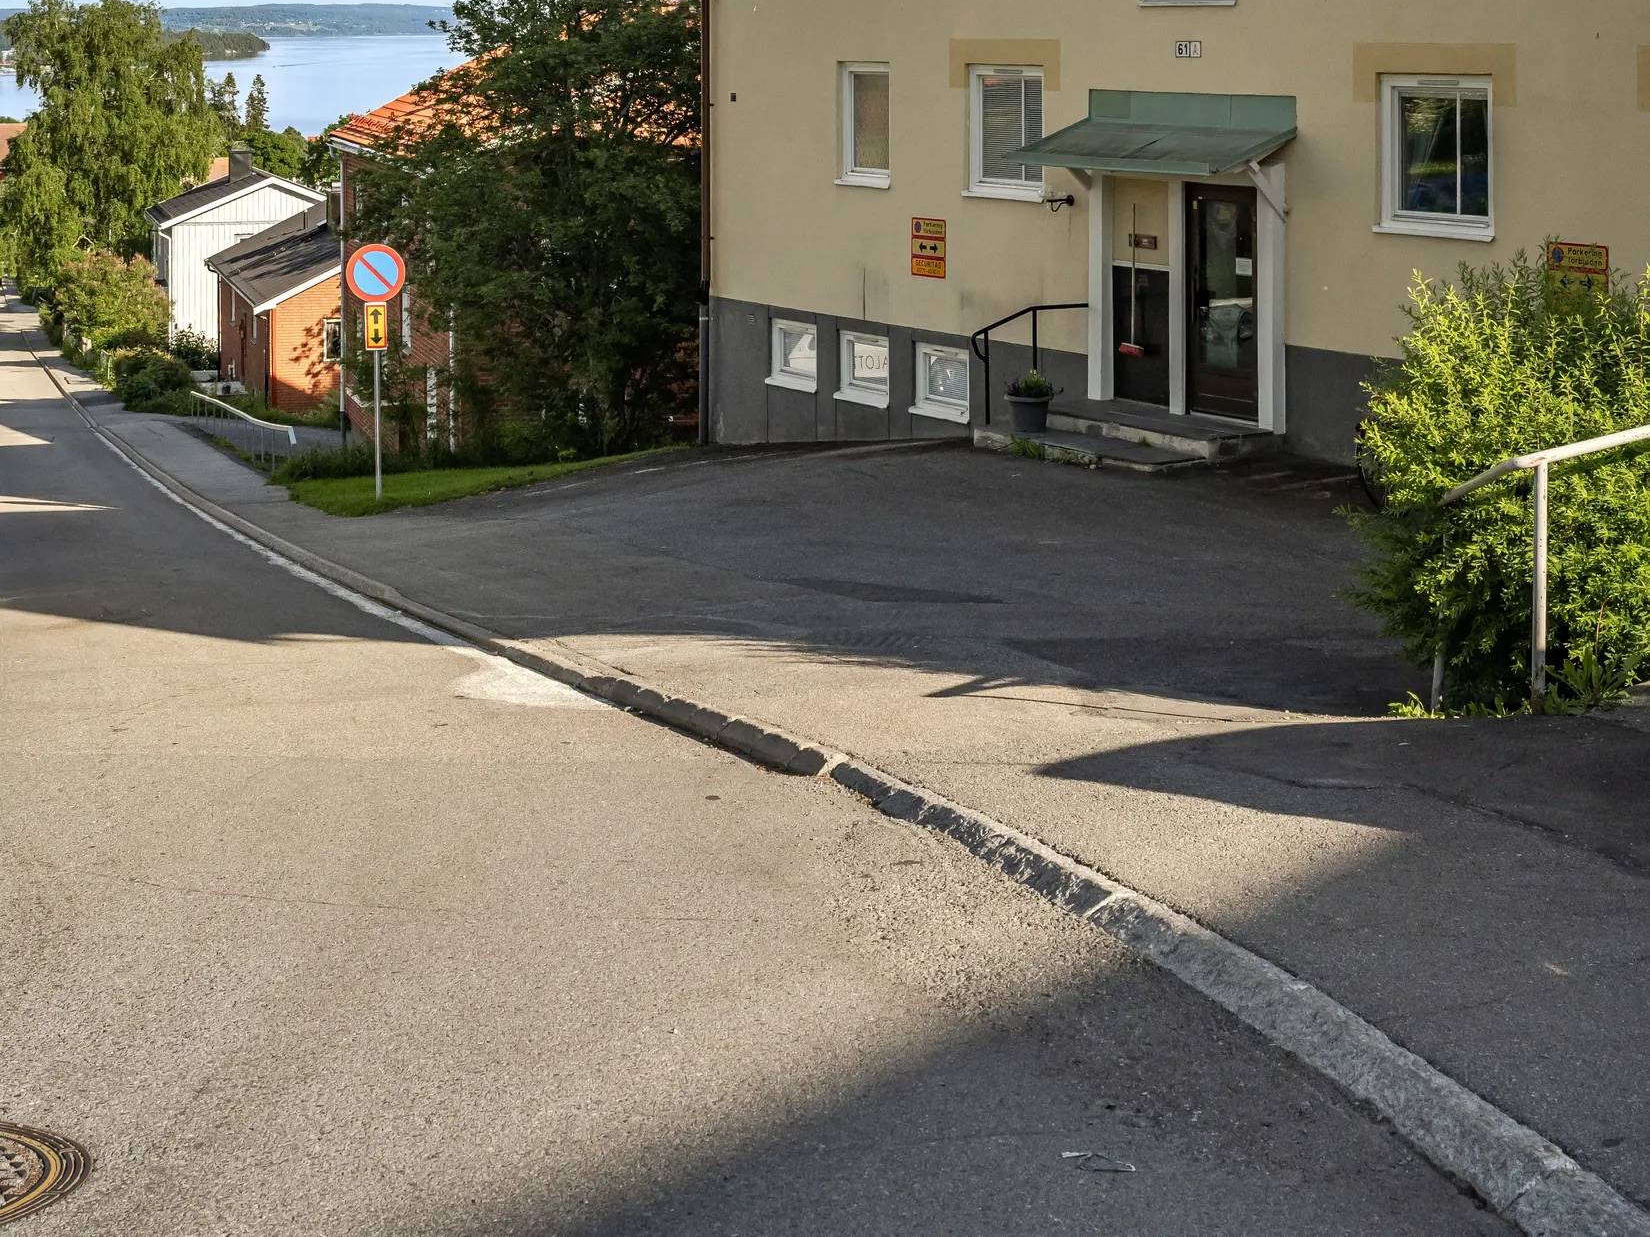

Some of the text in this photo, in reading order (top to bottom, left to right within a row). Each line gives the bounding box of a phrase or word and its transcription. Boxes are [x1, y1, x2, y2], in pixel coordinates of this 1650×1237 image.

[1178, 43, 1188, 55] 61
[923, 221, 943, 230] Parkering
[1567, 247, 1603, 259] Parkering
[915, 259, 942, 269] SECURITAS
